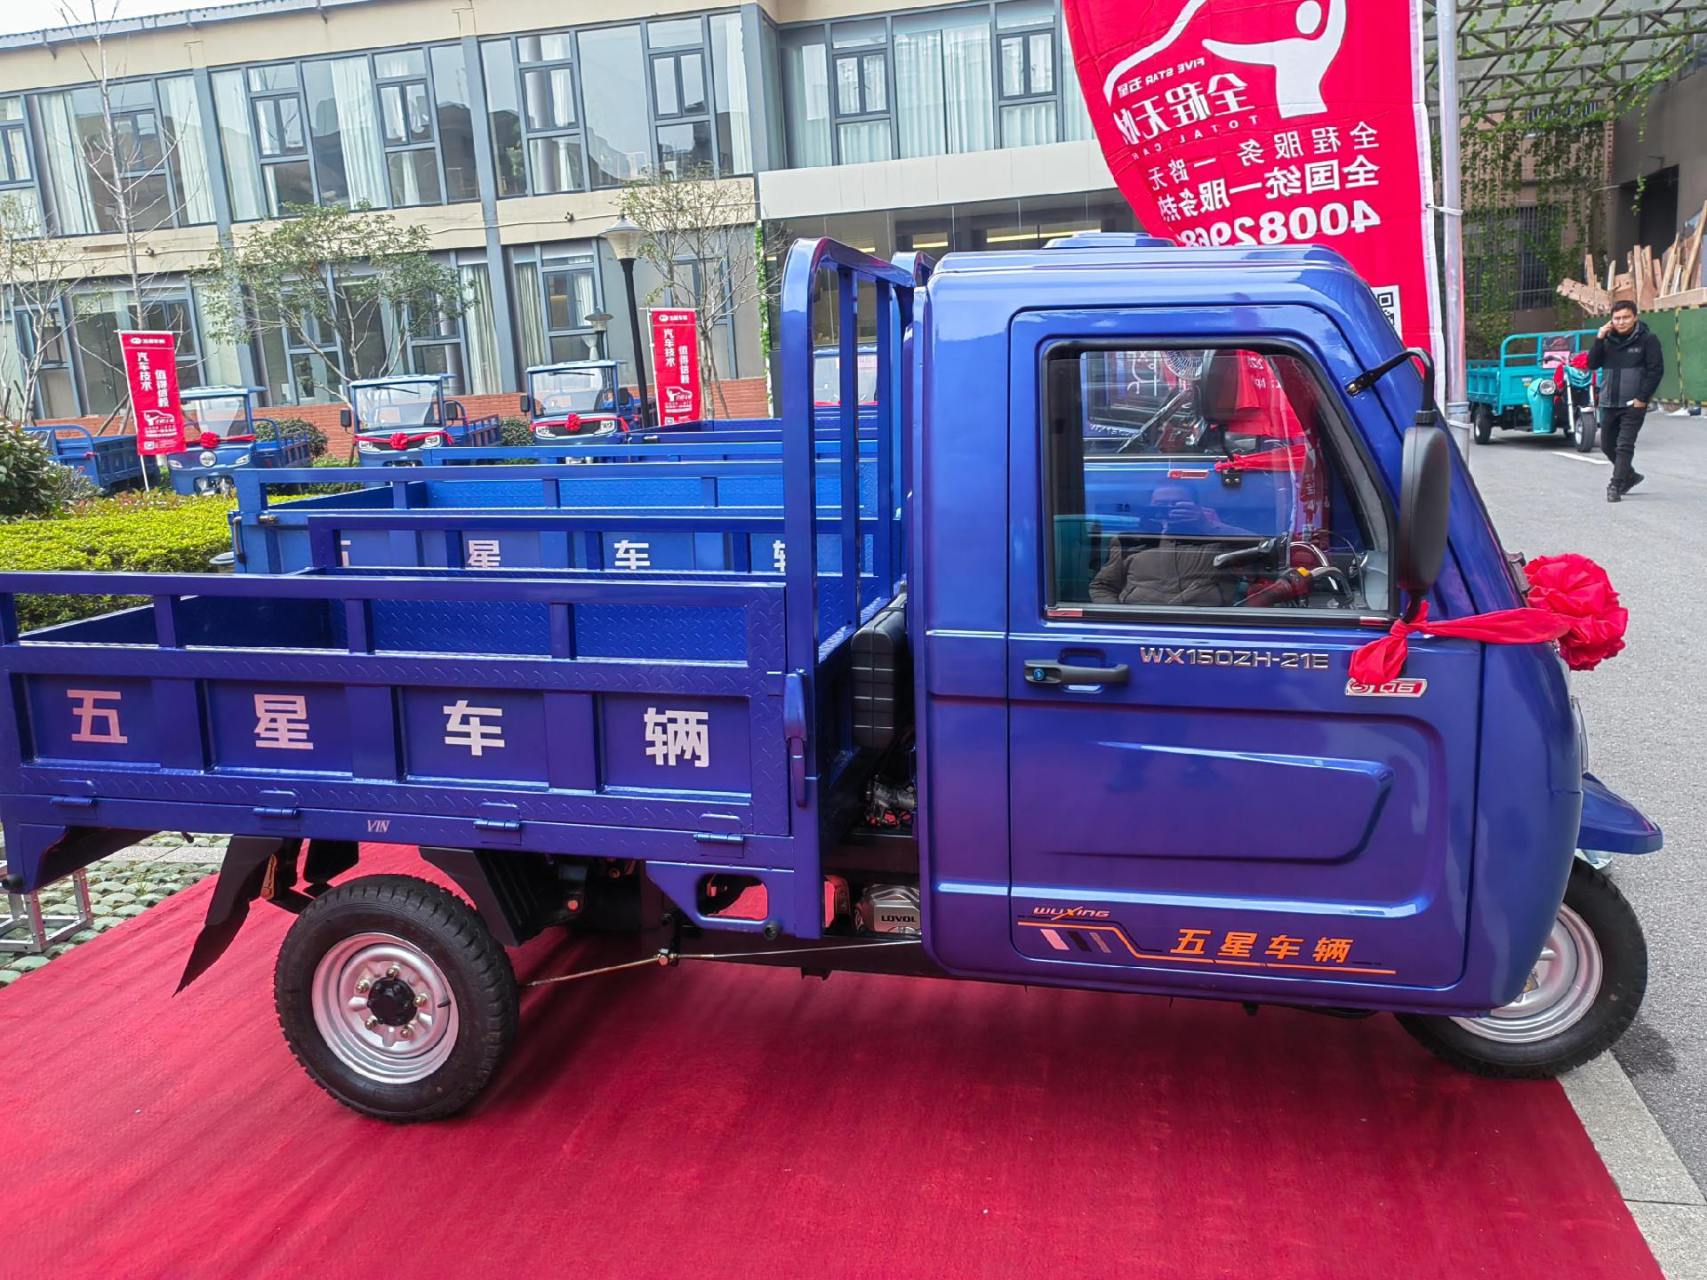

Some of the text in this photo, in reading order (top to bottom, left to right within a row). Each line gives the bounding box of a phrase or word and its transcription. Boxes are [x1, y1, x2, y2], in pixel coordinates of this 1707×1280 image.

[1139, 647, 1329, 669] WX150ZH-21E
[67, 689, 710, 767] 五星车辆
[367, 820, 390, 833] VIN
[1170, 928, 1353, 963] 五星车辆
